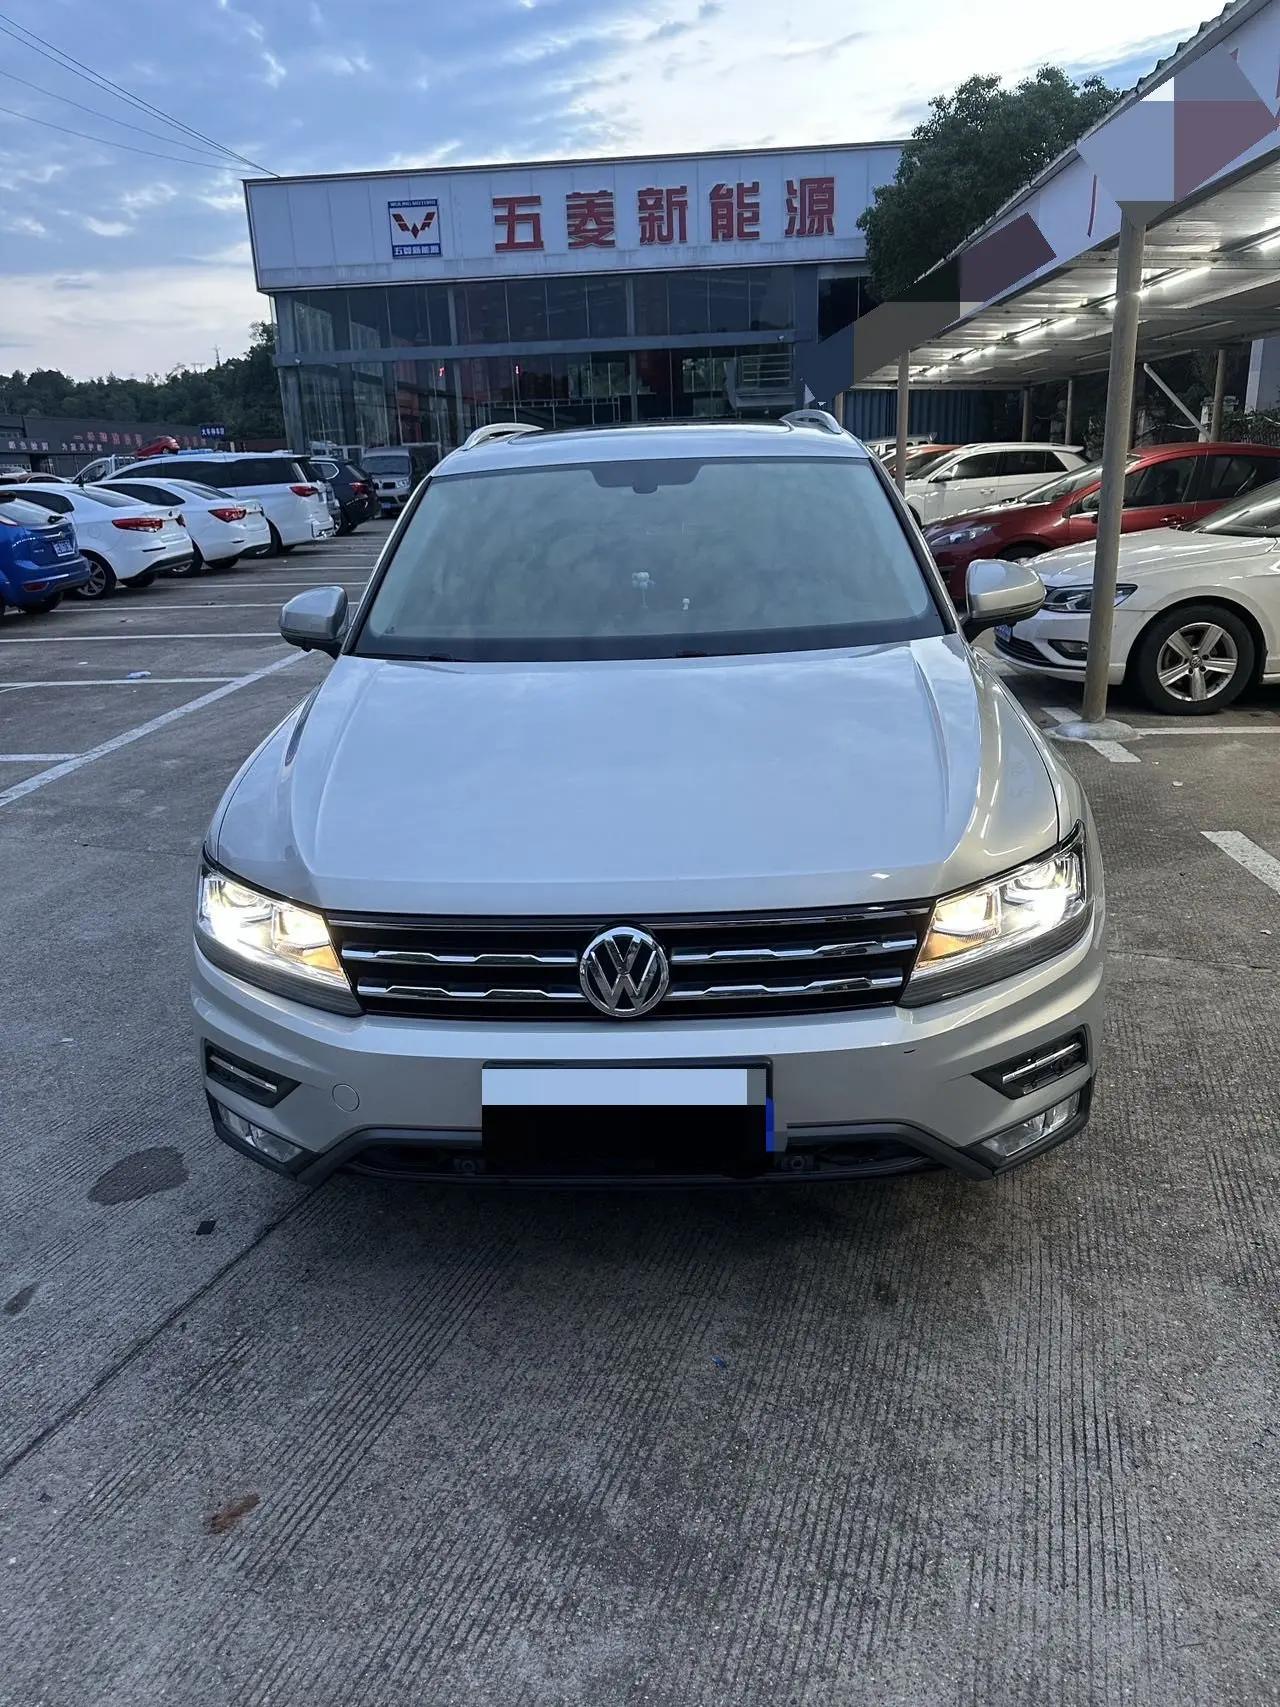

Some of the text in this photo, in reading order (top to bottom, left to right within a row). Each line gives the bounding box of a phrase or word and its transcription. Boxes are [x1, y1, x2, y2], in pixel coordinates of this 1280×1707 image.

[492, 176, 836, 252] 五菱新能源
[587, 933, 659, 1011] VW
